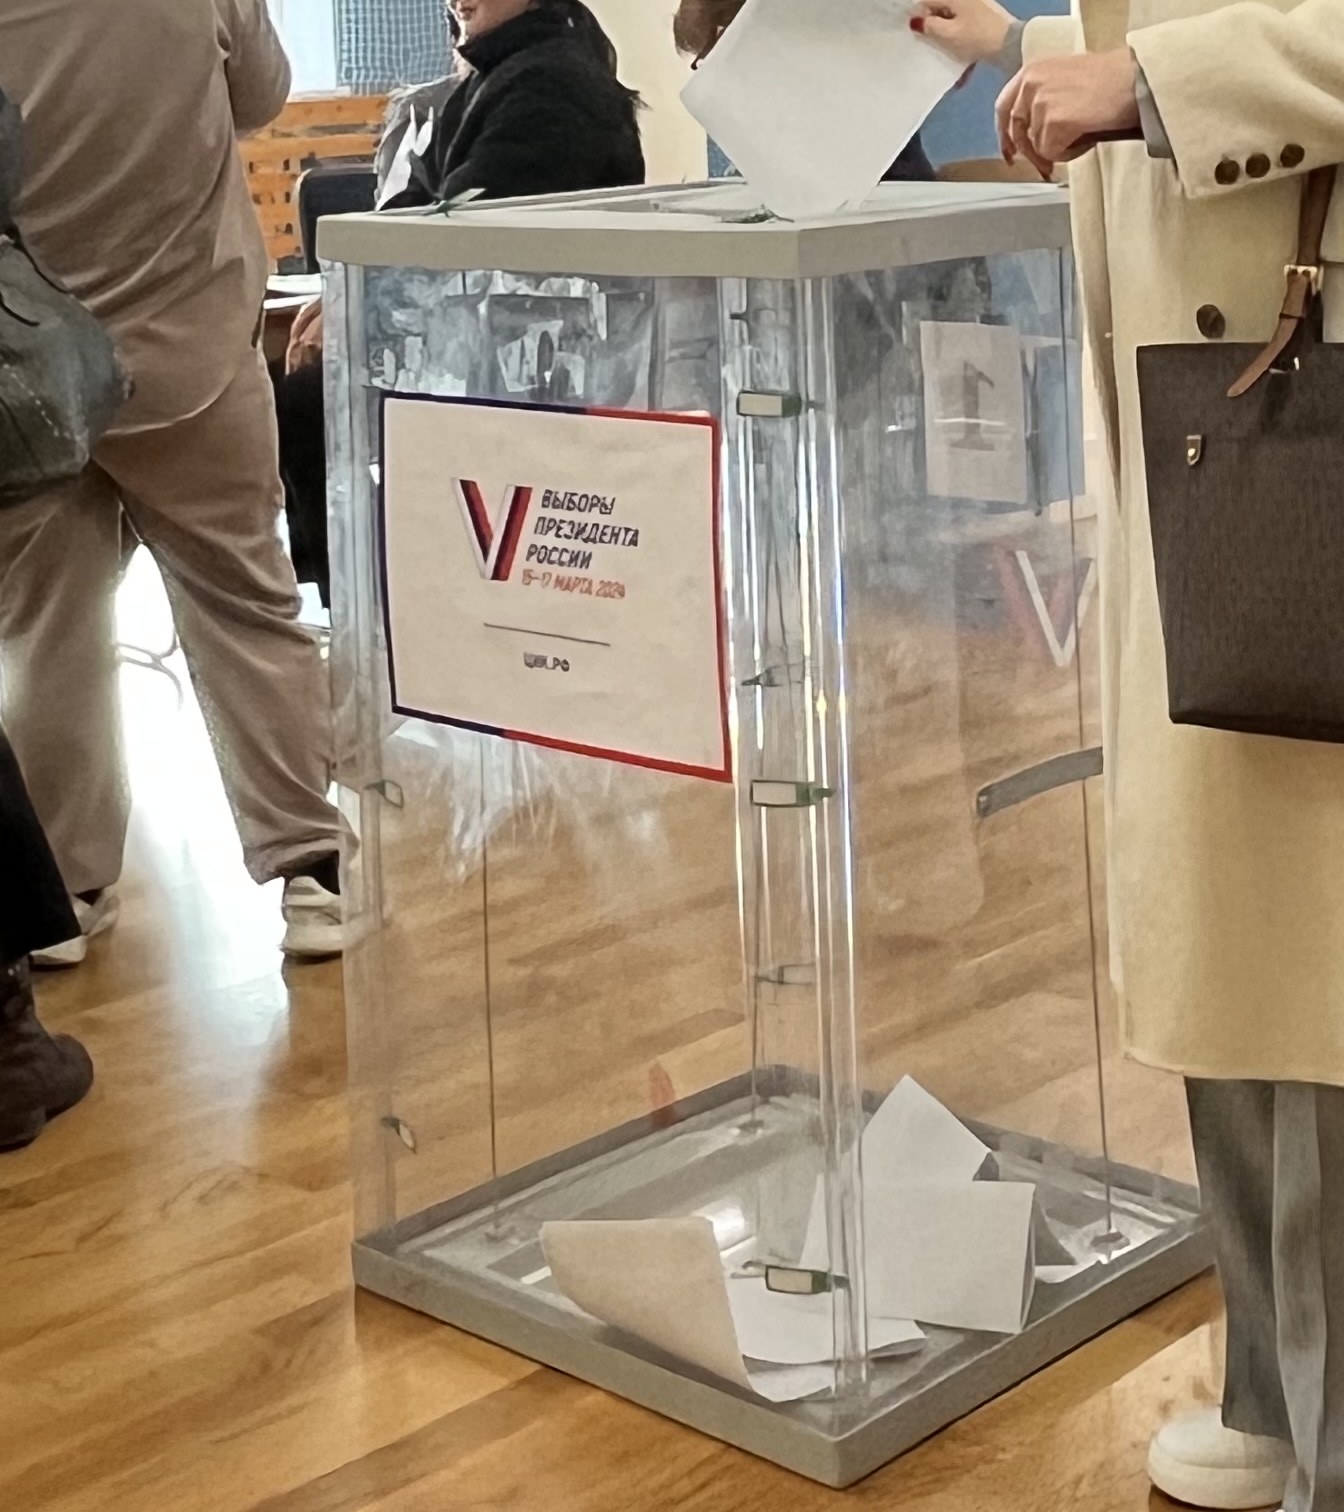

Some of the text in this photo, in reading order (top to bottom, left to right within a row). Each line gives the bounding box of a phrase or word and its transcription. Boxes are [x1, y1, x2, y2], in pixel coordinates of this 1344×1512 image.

[541, 488, 616, 515] ВЫБОРЫ
[451, 476, 533, 581] V
[533, 516, 640, 547] ПРЕЗИДЕНТА
[525, 543, 593, 570] РОССИИ
